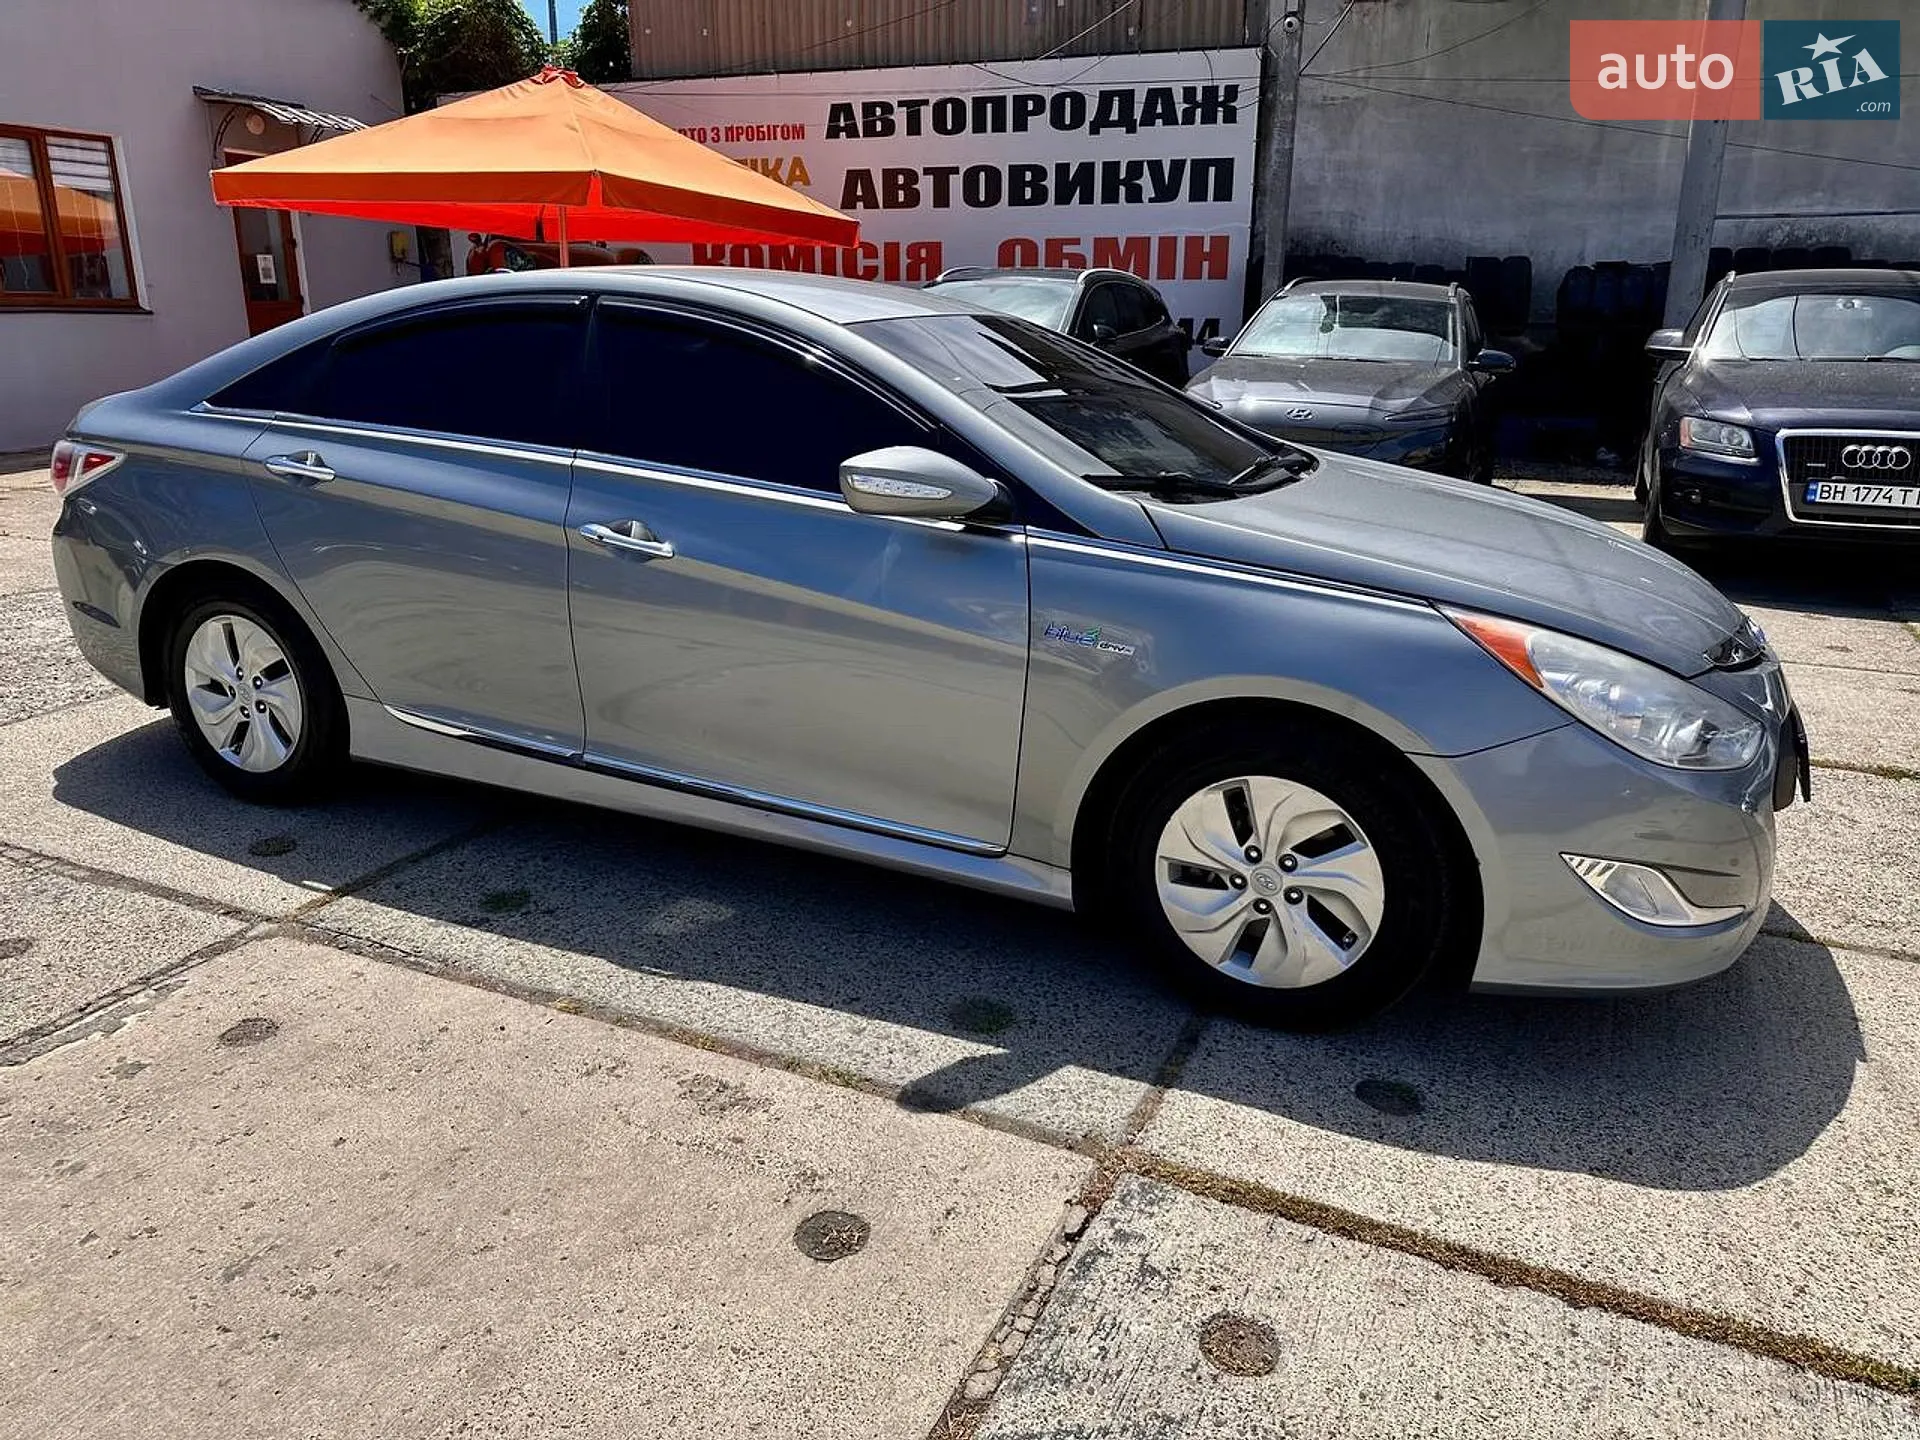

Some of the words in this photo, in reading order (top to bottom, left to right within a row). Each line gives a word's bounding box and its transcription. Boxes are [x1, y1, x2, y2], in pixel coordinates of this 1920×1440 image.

[724, 123, 805, 142] ПРОБІГОМ
[825, 84, 1240, 139] АВТОПРОДАЖ
[840, 157, 1235, 210] АВТОВИКУП
[997, 235, 1230, 280] ОБМІН
[1819, 484, 1846, 501] BH
[1852, 487, 1893, 504] 1774
